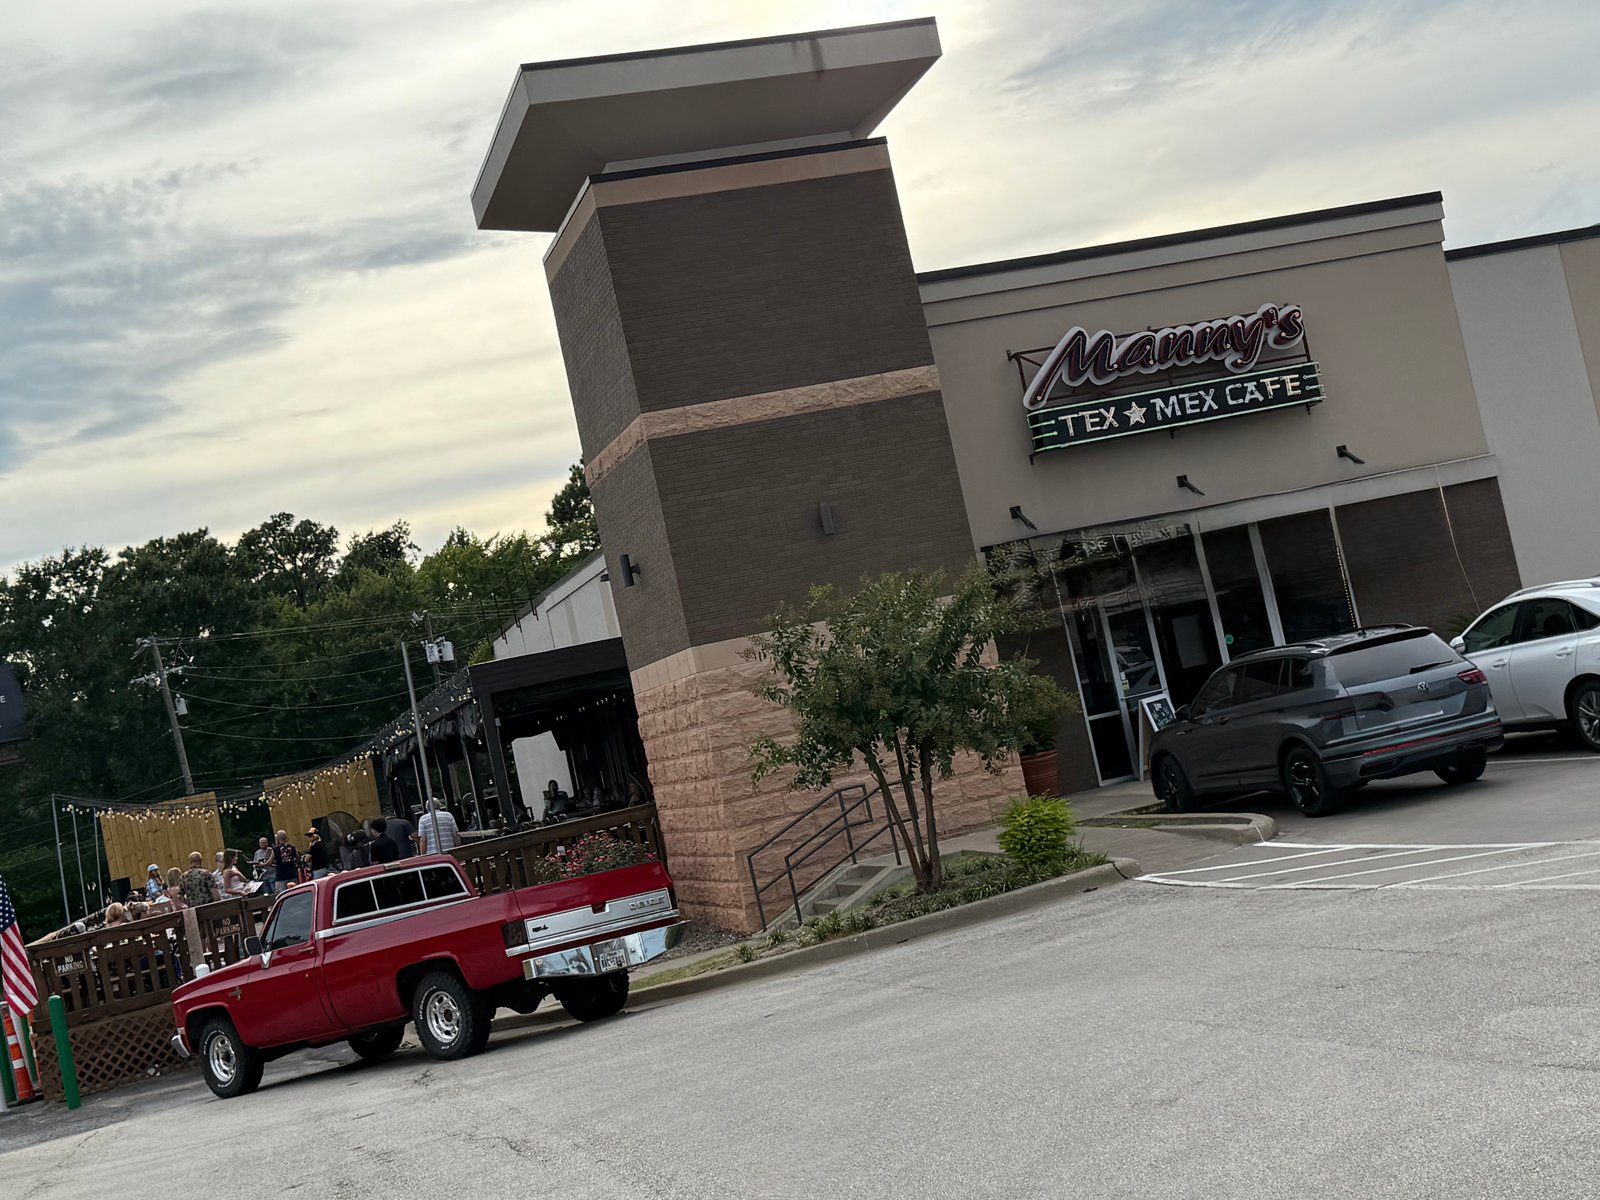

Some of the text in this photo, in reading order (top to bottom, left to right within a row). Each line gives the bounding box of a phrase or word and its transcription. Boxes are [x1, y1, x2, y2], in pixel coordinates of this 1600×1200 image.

[1023, 303, 1304, 409] Manny's
[1058, 374, 1302, 436] TEX MEX CAFE
[222, 916, 231, 926] NO
[215, 923, 241, 937] PARKING
[64, 954, 74, 964] NO
[57, 960, 84, 974] PARKING
